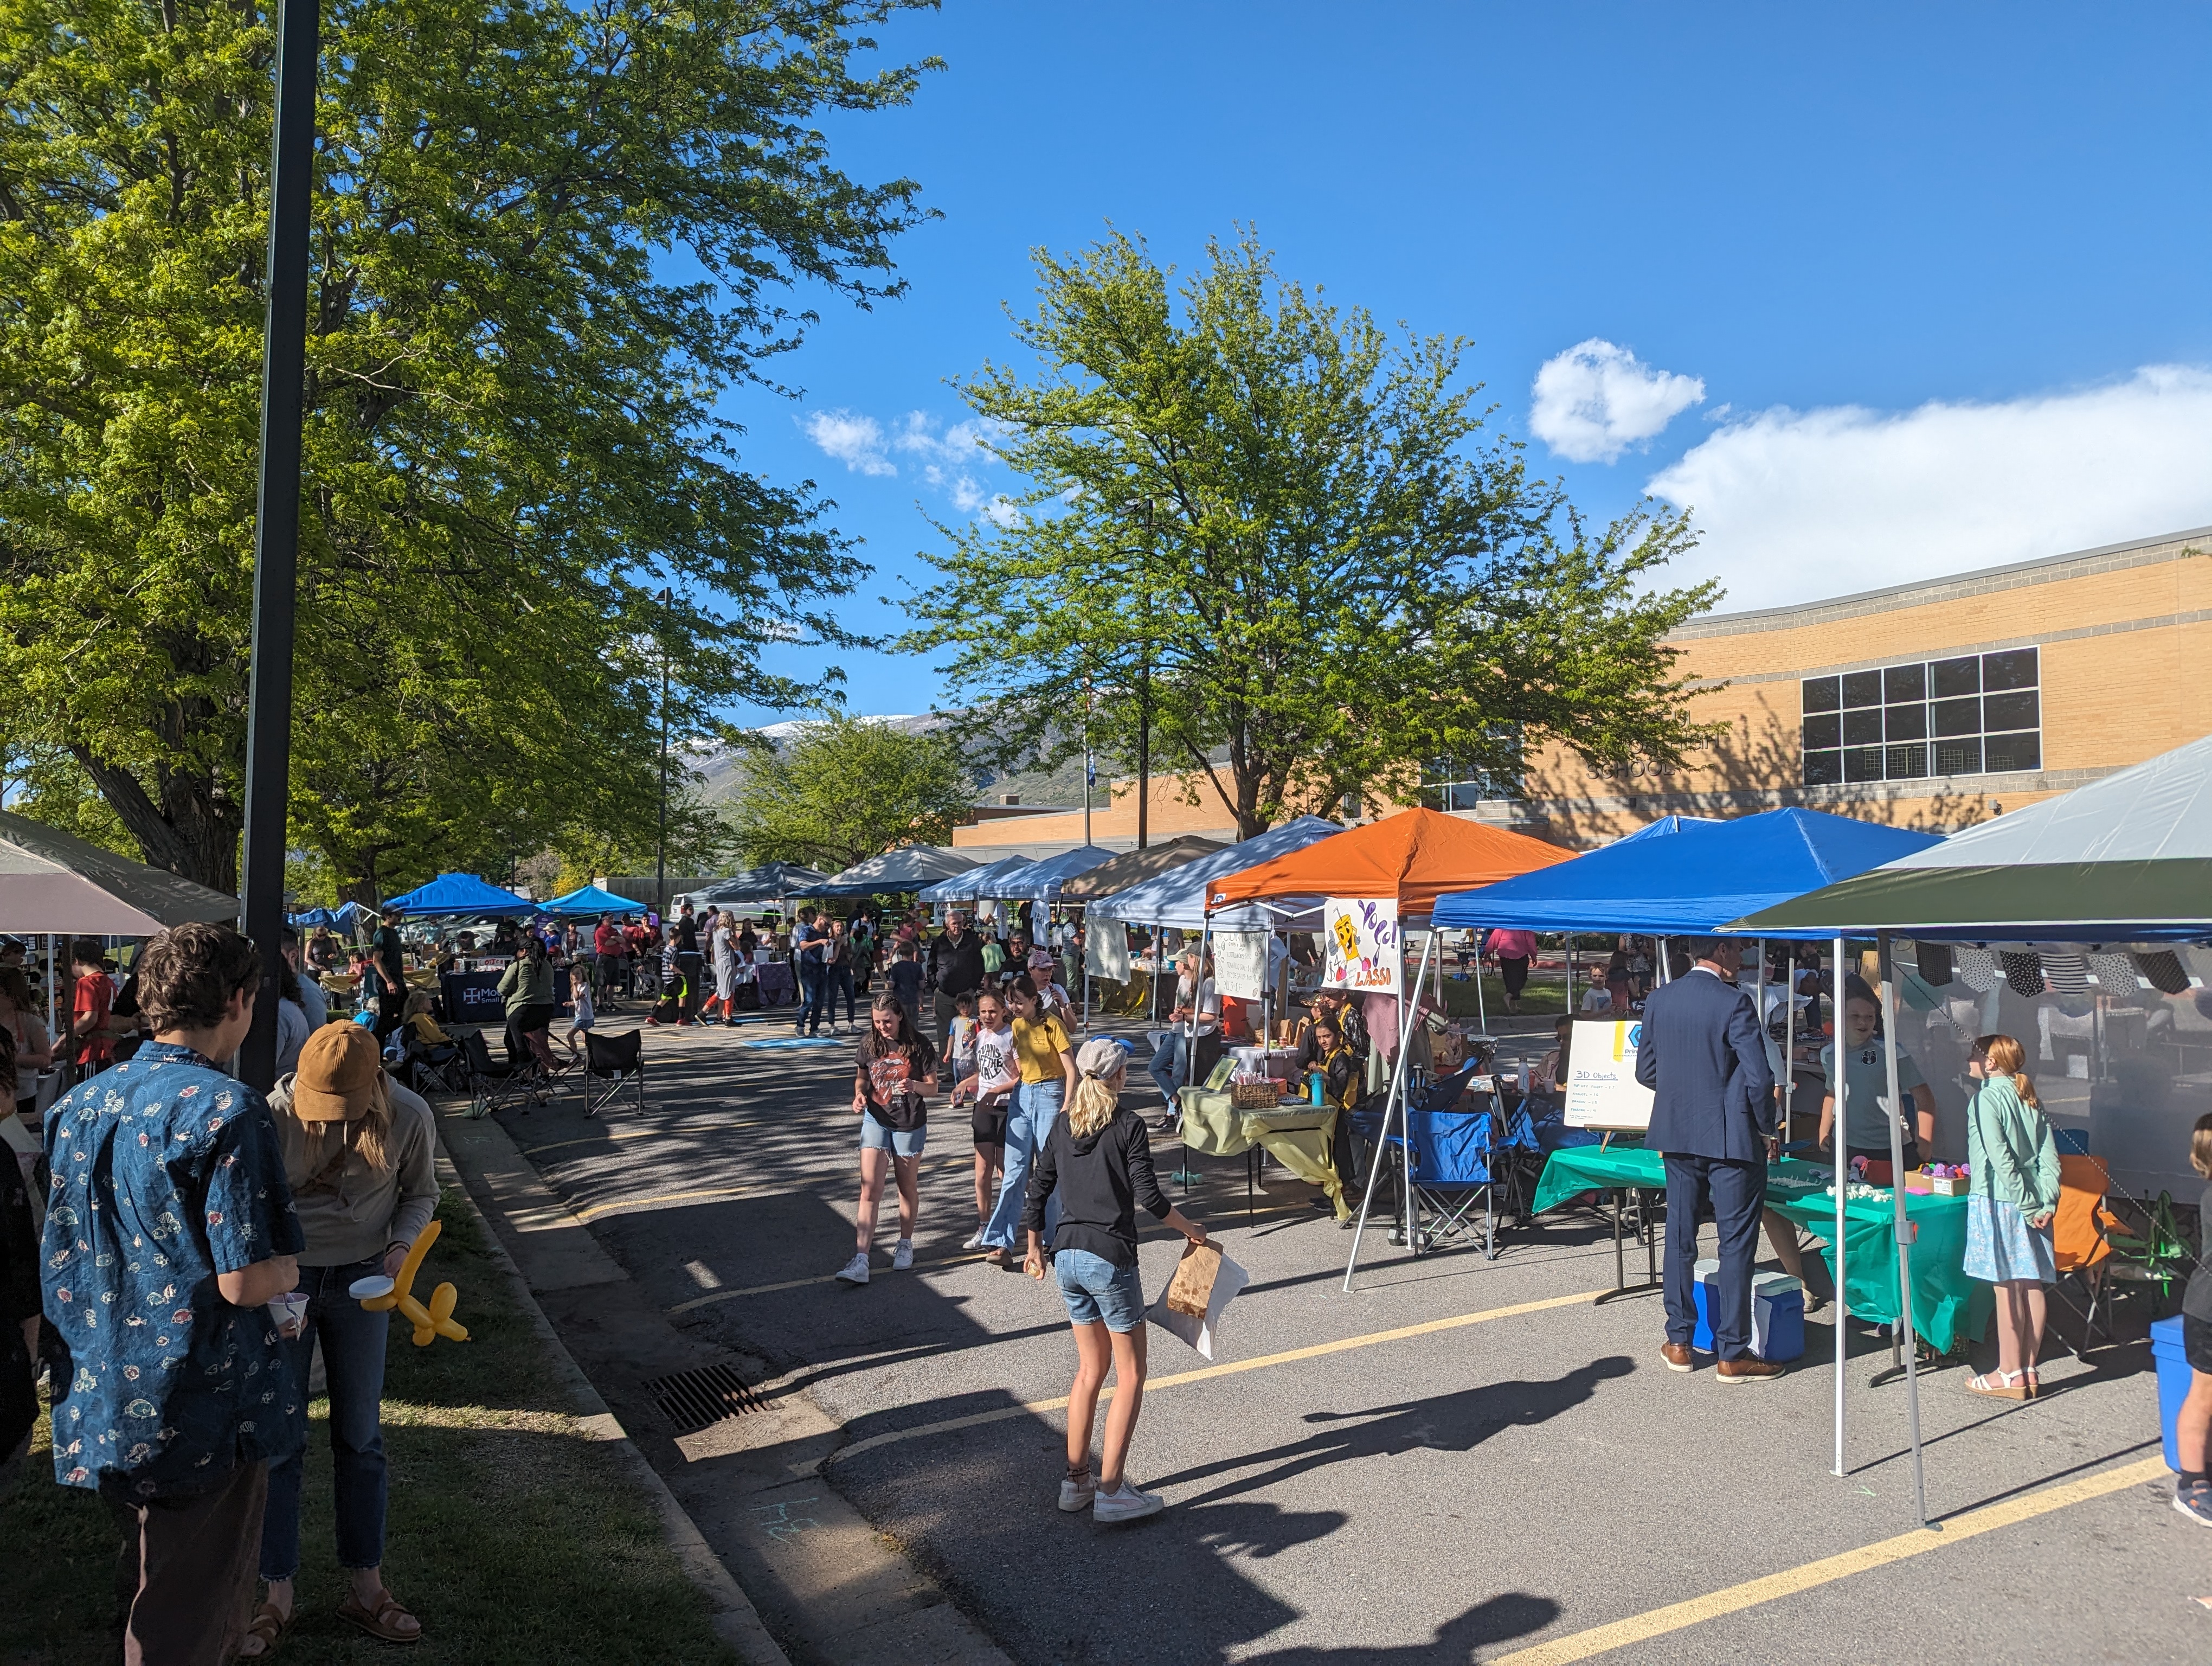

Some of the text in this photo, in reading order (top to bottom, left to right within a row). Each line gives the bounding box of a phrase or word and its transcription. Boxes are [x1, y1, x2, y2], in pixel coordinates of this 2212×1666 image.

[1586, 760, 1675, 779] SCHOOL
[1355, 967, 1391, 986] LASSI
[981, 1043, 1001, 1058] VANS
[1576, 1070, 1616, 1081] 3D Objects
